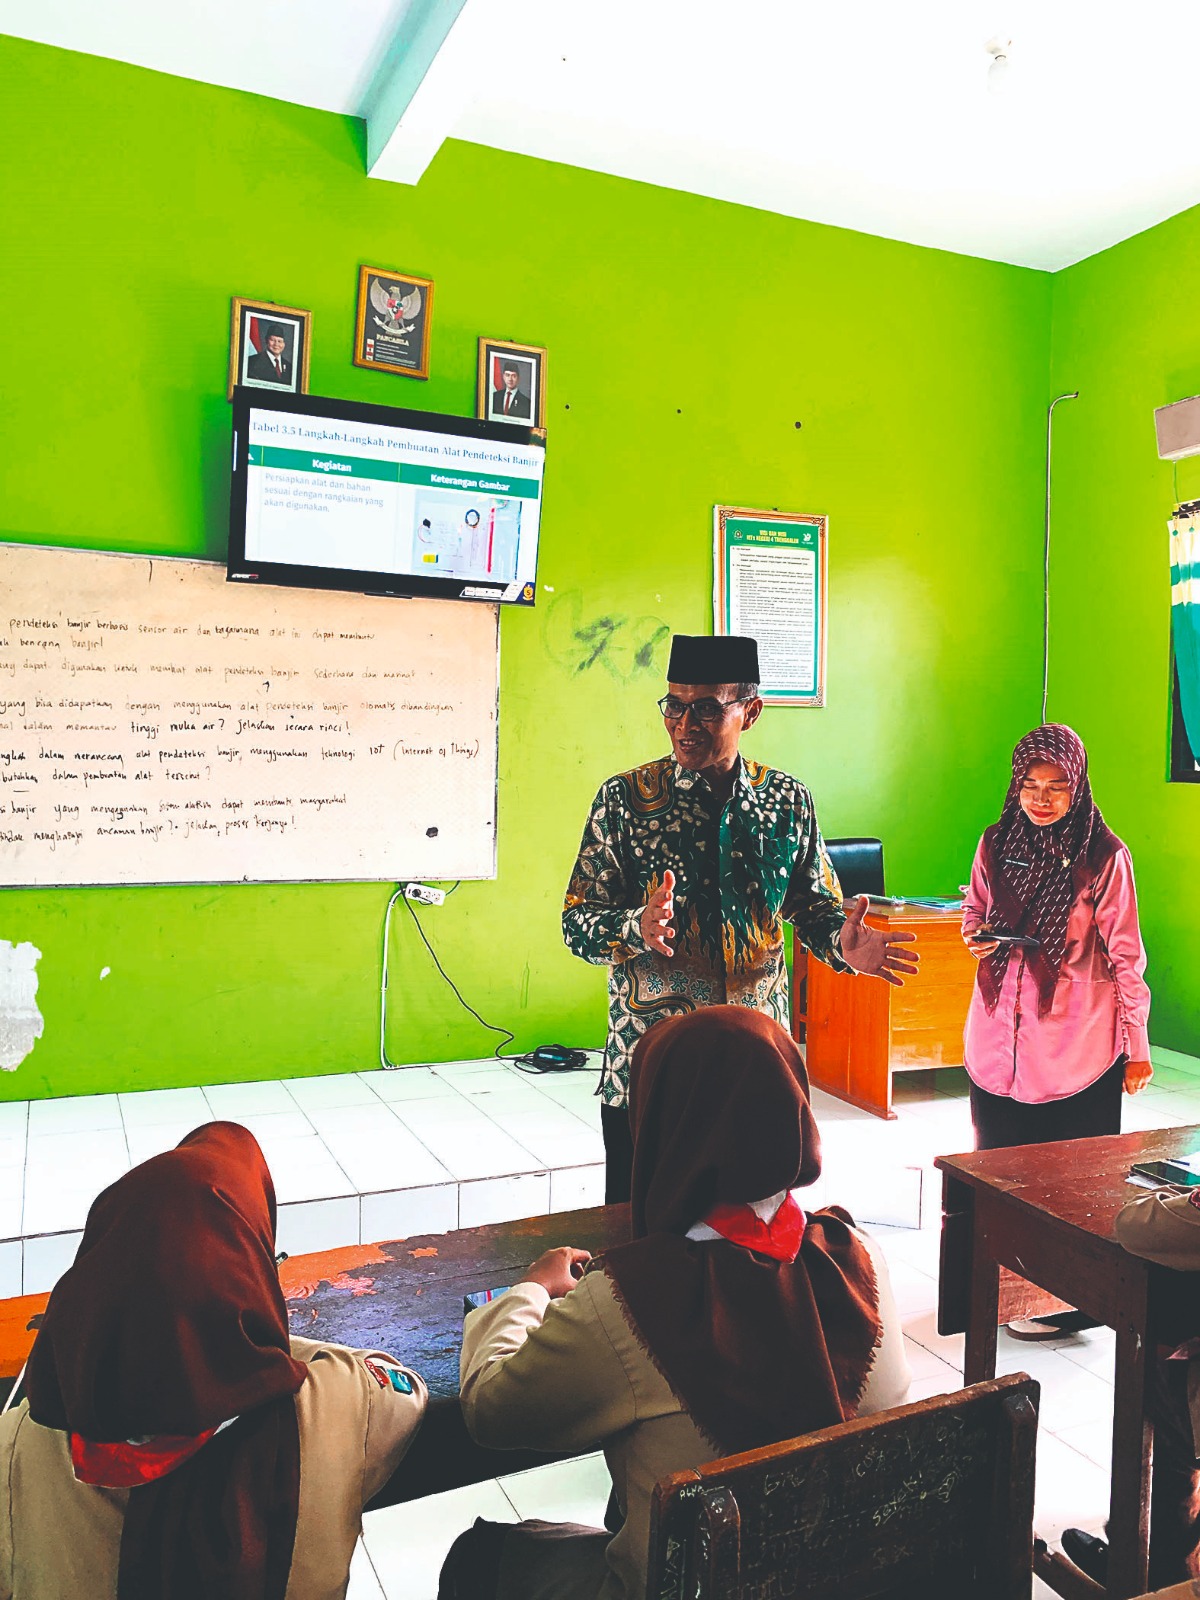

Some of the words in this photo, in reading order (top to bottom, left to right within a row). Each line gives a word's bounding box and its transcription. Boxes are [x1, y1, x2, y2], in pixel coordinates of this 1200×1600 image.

[253, 422, 278, 433] Tabel
[282, 424, 296, 435] 3.5
[298, 427, 384, 447] Langkah-Langkah
[387, 439, 439, 454] Pembuatan
[442, 447, 460, 457] Alat
[463, 449, 510, 464] Pendeteksi
[513, 456, 539, 468] Banjir
[312, 459, 352, 474] Kegiatan
[265, 472, 310, 487] Persiapkan
[311, 476, 328, 487] alat
[329, 478, 344, 490] dan
[346, 481, 371, 493] bahan
[430, 474, 477, 488] Keterangan
[479, 479, 510, 491] Gambar
[264, 486, 291, 497] sesuai
[293, 488, 322, 504] dengan
[324, 492, 363, 505] rangkaian
[365, 496, 383, 508] yang
[264, 498, 284, 510] akan
[286, 500, 330, 514] digunakan.
[138, 624, 167, 634] sensor
[173, 626, 188, 634] air
[131, 722, 160, 739] tinggi
[285, 723, 313, 731] secara
[0, 750, 26, 766] ngkah
[39, 747, 64, 760] dalam
[135, 771, 153, 780] alat
[54, 805, 79, 822] yang
